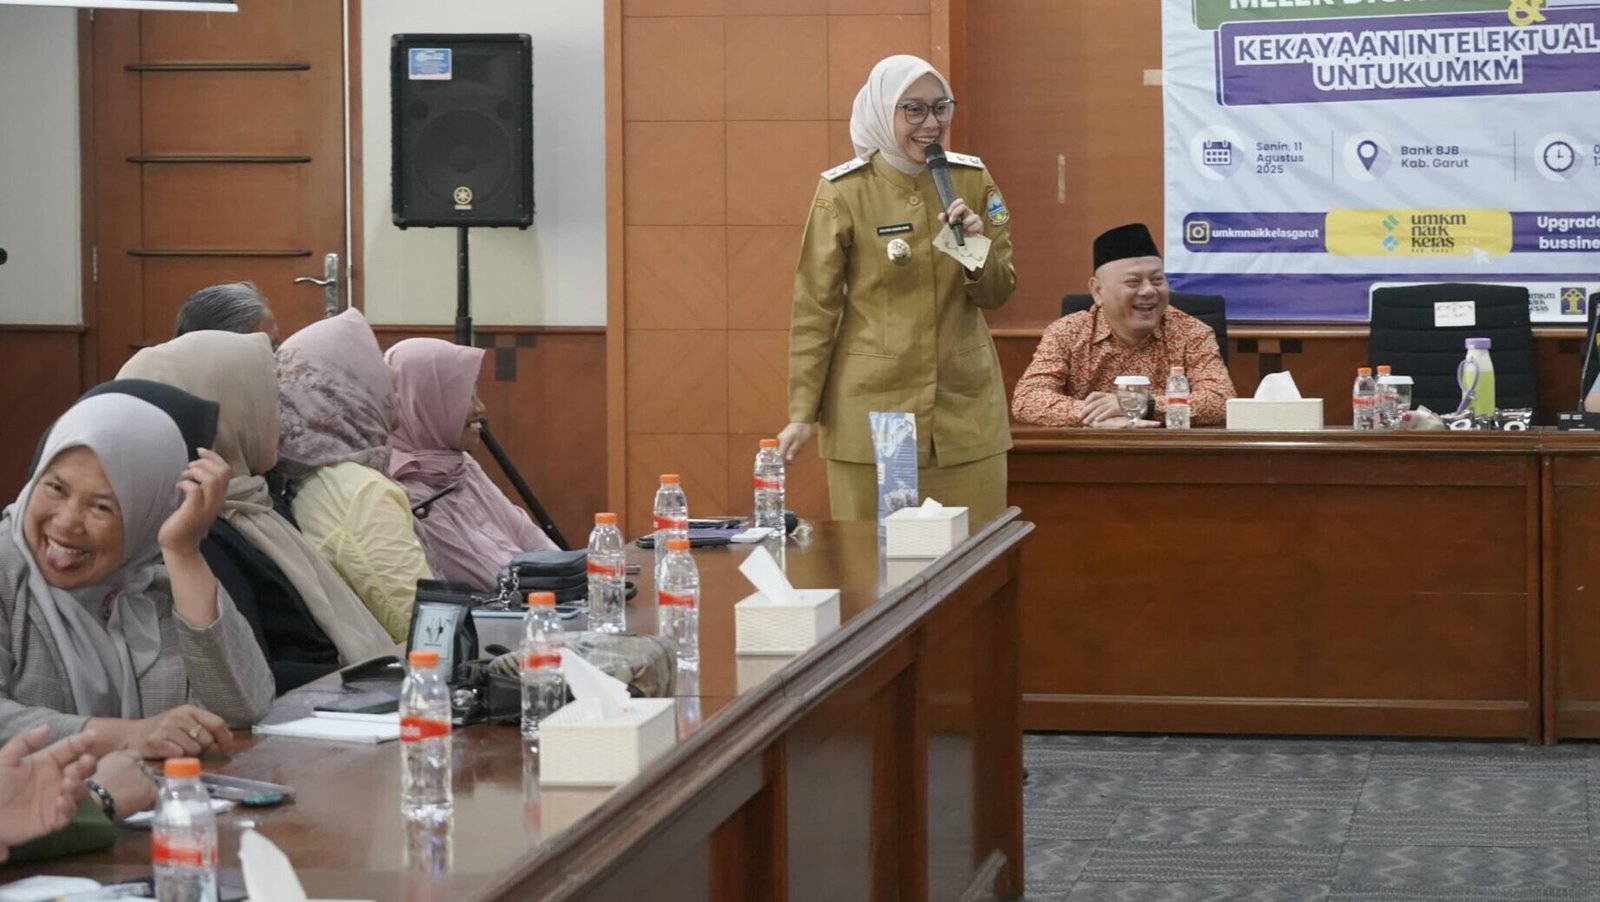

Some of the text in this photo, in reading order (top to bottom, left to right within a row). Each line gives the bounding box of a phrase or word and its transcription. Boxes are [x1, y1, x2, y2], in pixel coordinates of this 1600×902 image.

[1238, 27, 1597, 61] KEKAYAAN INTELEKTUAL
[1316, 58, 1520, 87] UNTUK UMKM
[1401, 145, 1460, 155] Bank BJB
[1256, 154, 1304, 165] Agustus
[1401, 158, 1469, 168] Kab. Garut
[1256, 165, 1284, 174] 2025
[1411, 214, 1467, 225] umkm
[1212, 227, 1319, 239] umkmnaikkelasgarut
